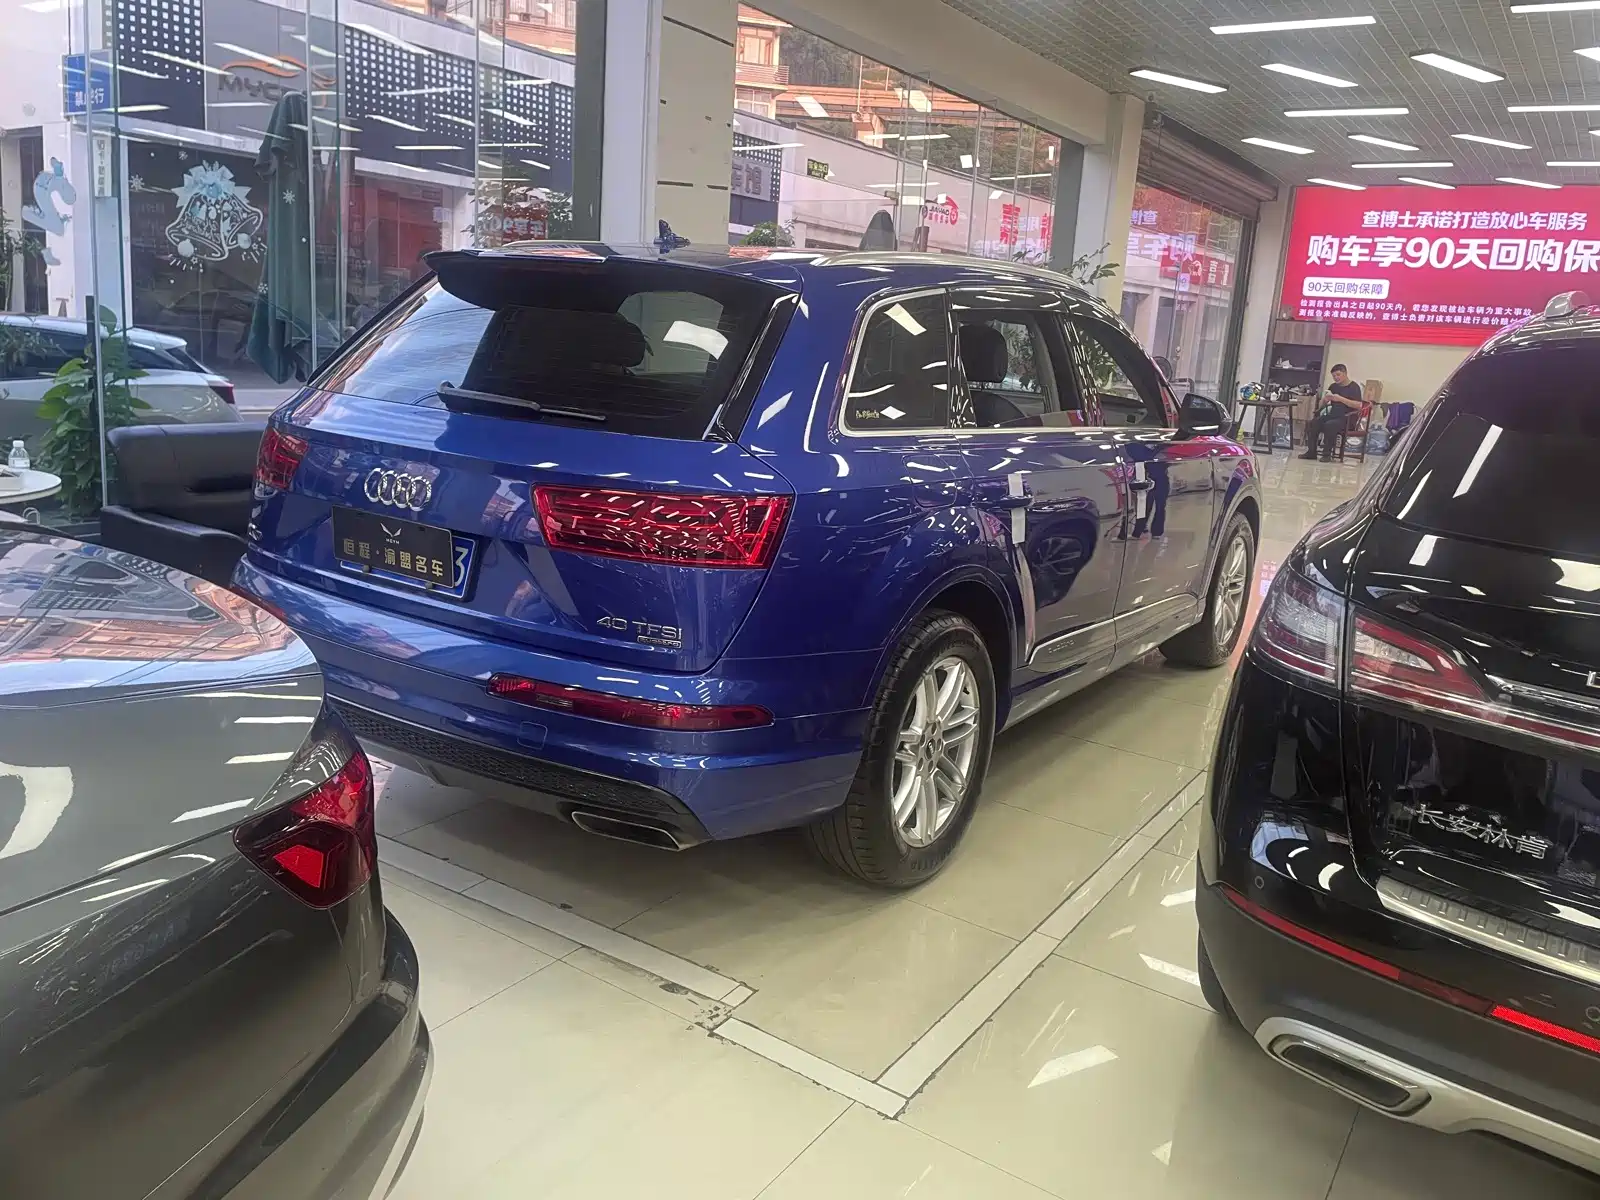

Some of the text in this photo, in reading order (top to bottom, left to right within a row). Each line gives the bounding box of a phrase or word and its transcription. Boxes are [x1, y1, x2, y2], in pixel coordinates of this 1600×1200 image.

[1361, 209, 1588, 231] 查博士承诺打造放心车服务
[1306, 235, 1600, 274] 购车享90天回购保
[1308, 281, 1384, 296] 90天回购保障
[596, 615, 683, 640] 40 TFSI
[1415, 802, 1549, 860] 长安林肯
